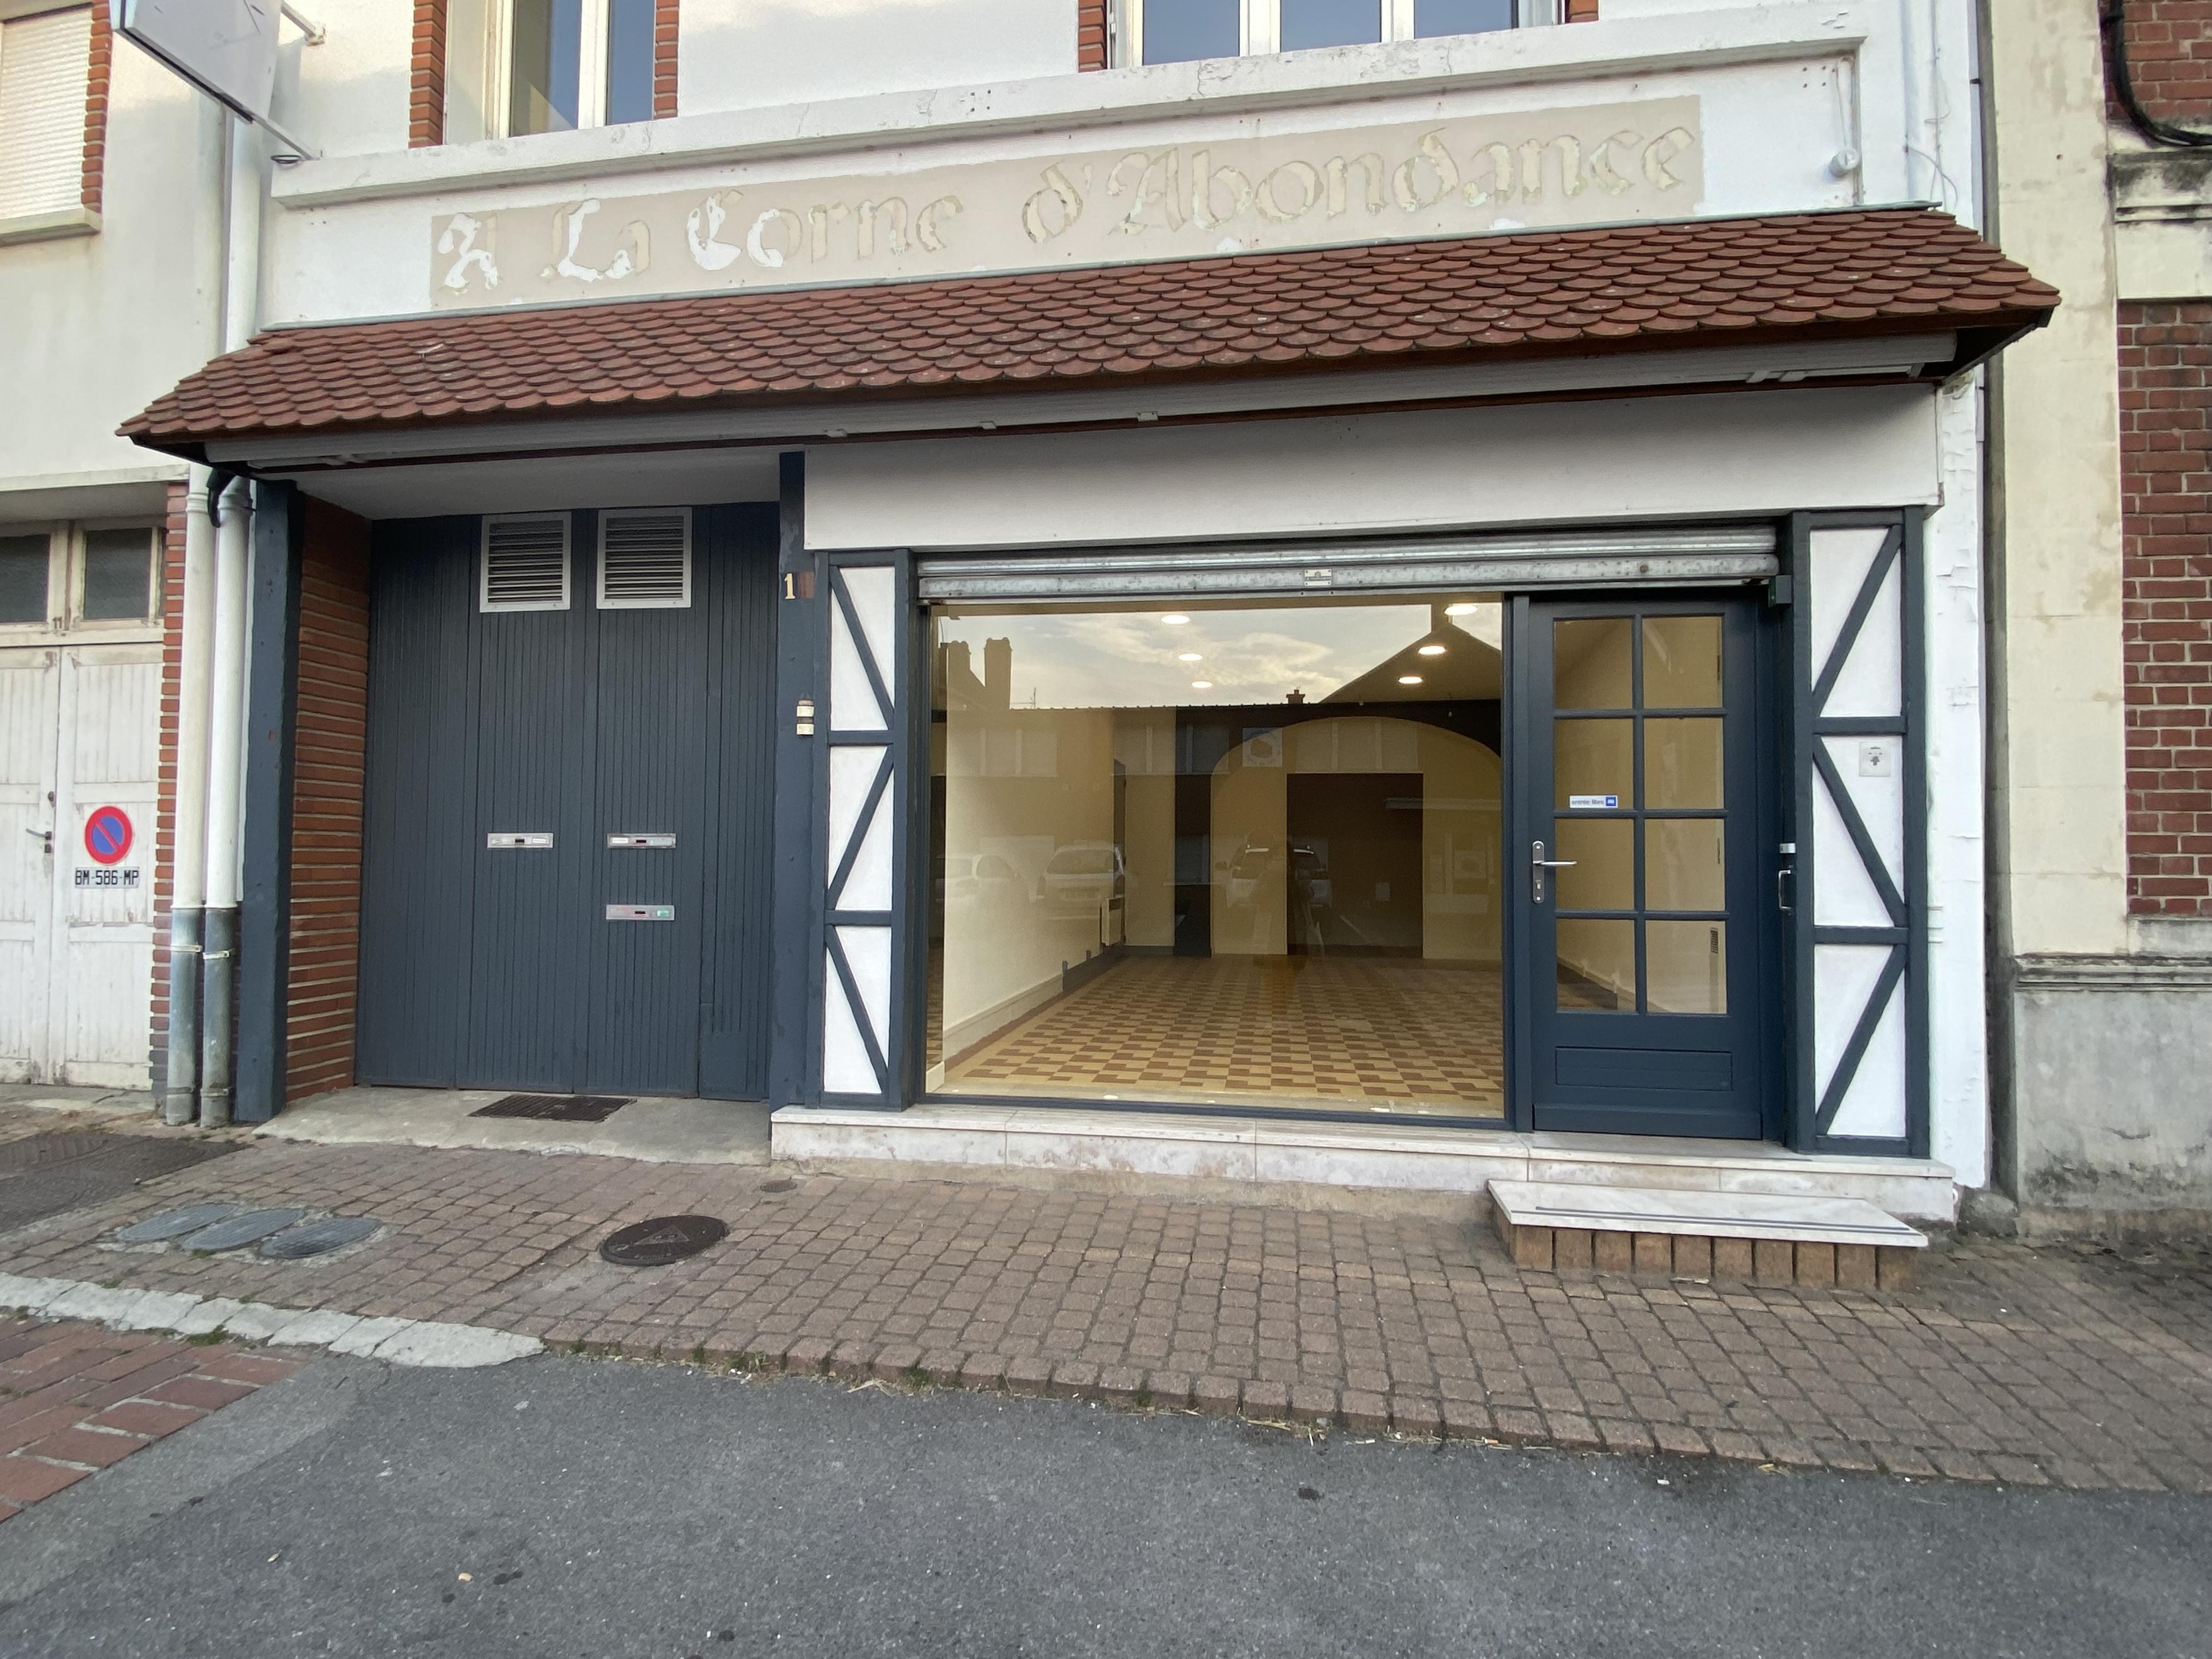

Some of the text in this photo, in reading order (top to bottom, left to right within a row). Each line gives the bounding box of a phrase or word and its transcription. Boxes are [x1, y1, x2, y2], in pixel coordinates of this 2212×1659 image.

[539, 197, 651, 282] La
[685, 189, 963, 271] Corne
[1022, 127, 1695, 243] d'Abondance
